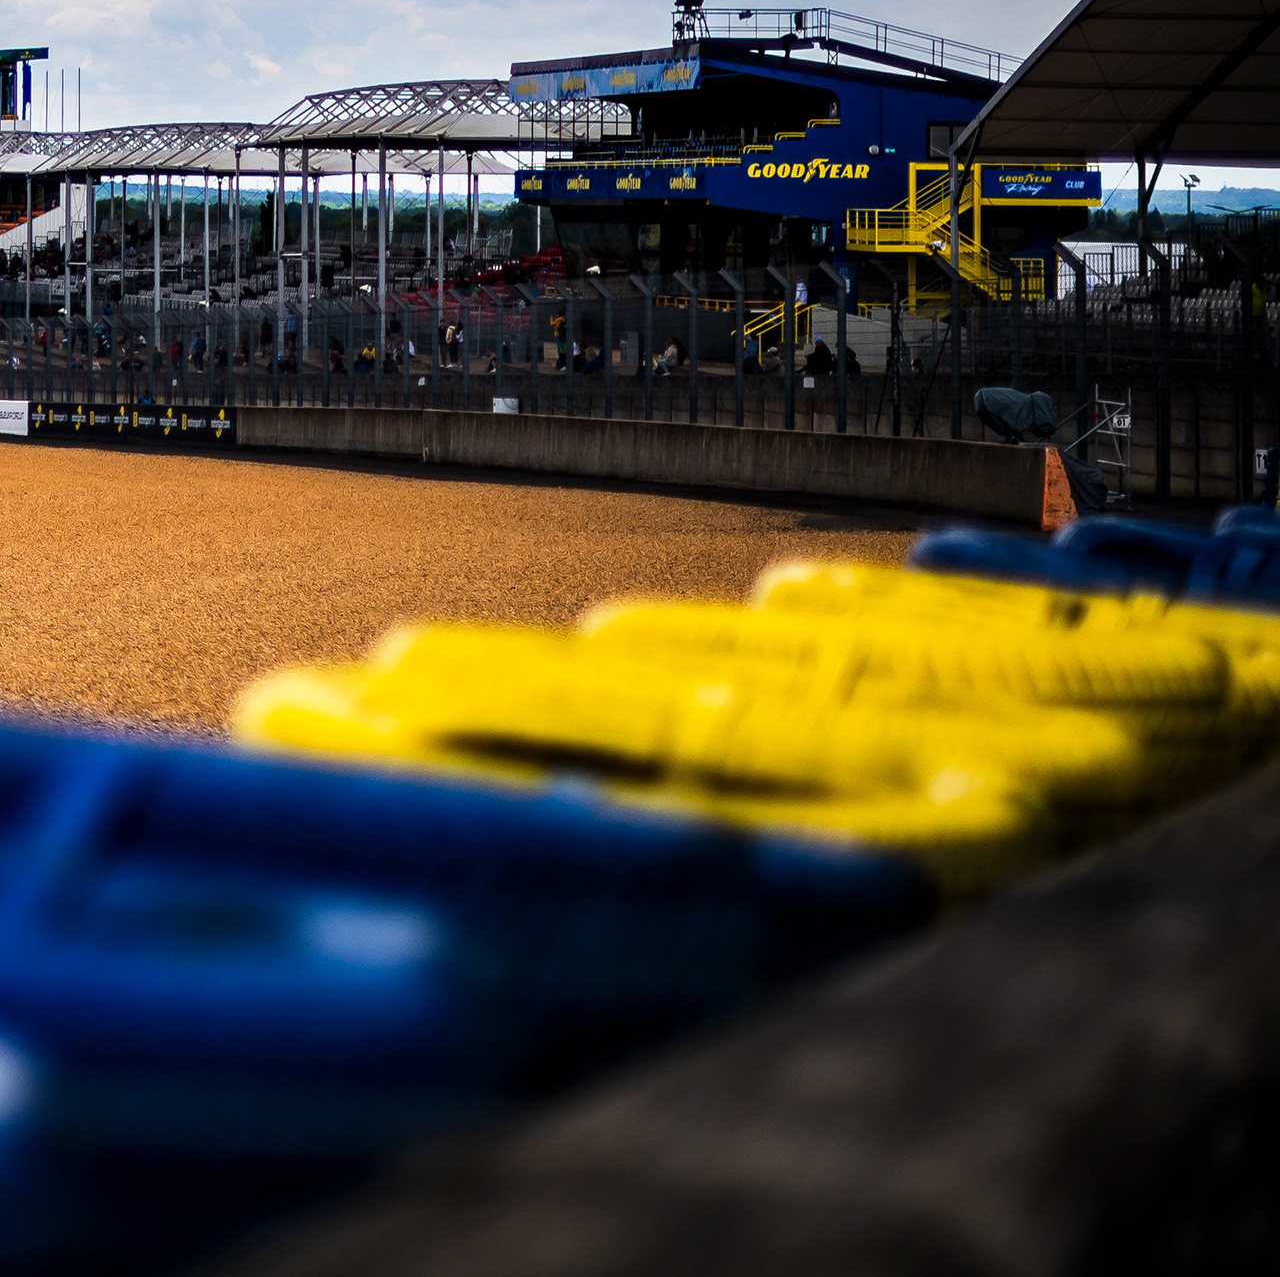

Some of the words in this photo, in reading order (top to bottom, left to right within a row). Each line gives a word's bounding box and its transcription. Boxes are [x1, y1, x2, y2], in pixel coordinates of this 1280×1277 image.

[747, 161, 870, 180] GOODYEAR
[521, 178, 542, 191] GOODYEAR
[567, 177, 590, 190] GOODYEAR
[616, 176, 641, 190] GOODYEAR
[670, 174, 697, 190] GOODYEAR
[999, 174, 1052, 184] GOODYEAR
[1065, 181, 1085, 189] CLUB
